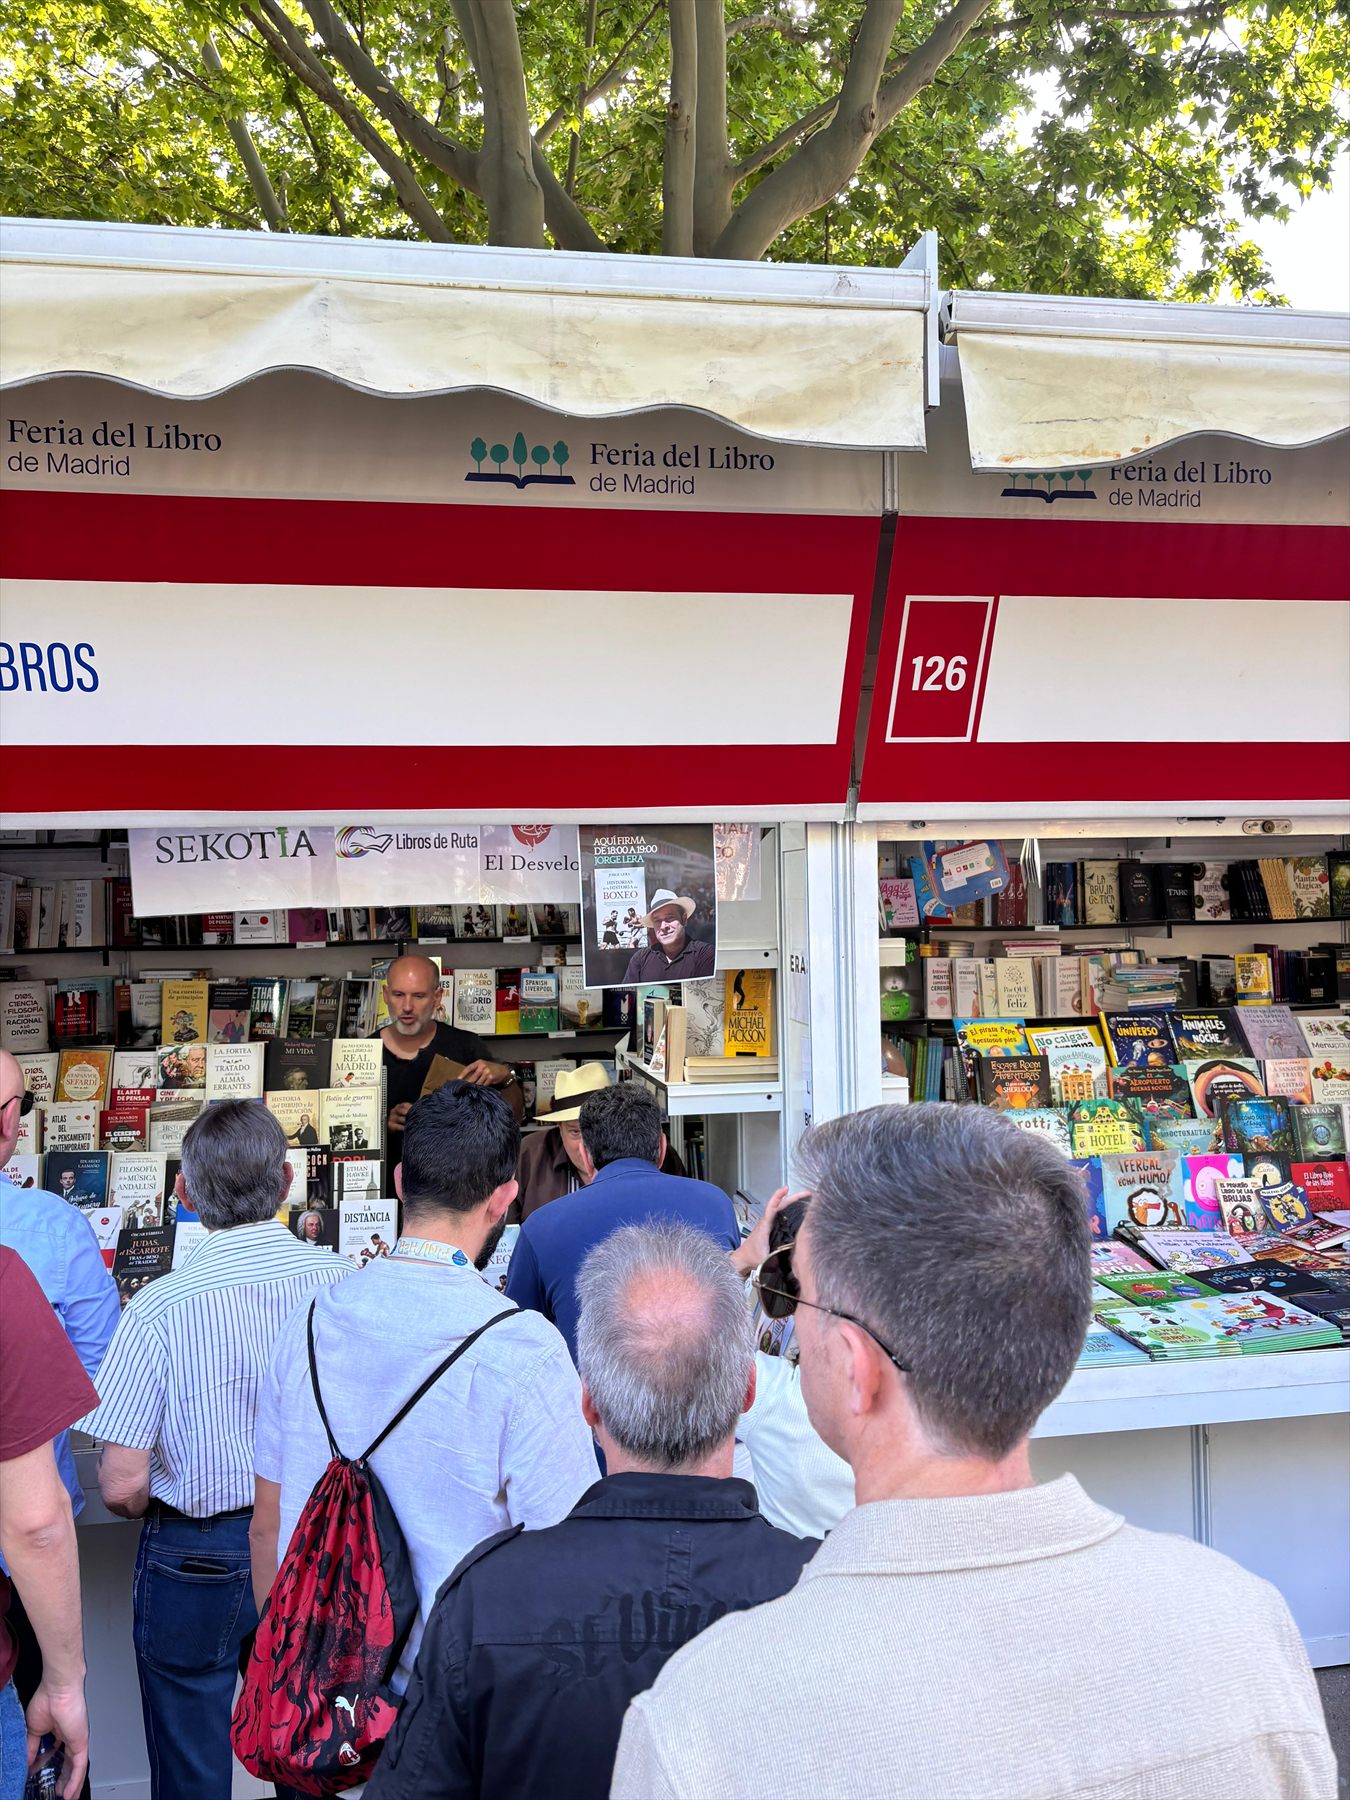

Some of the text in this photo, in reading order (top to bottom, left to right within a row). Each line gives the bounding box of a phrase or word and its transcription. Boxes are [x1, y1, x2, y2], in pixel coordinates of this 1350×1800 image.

[7, 419, 221, 453] Feria del Libro
[590, 443, 775, 471] Feria del Libro
[8, 451, 130, 476] de Madrid
[1109, 462, 1272, 485] Feria del Libro
[590, 473, 695, 495] de Madrid
[1109, 488, 1201, 508] de Madrid
[912, 656, 968, 691] 126
[396, 833, 478, 850] Libros de Ruta
[593, 834, 646, 847] AQUÍ FIRMA
[594, 844, 658, 855] DE 18:00 A 19:00
[484, 855, 502, 870] El
[594, 855, 644, 866] JORGE LERA
[1097, 875, 1106, 885] LA
[603, 891, 638, 900] BOXEO
[1008, 999, 1028, 1008] feliz
[6, 1018, 42, 1026] RACIONAL
[458, 1014, 492, 1022] HISTORIA
[728, 1017, 765, 1030] MICHAEL
[978, 1027, 998, 1036] pirata
[1000, 1026, 1016, 1036] Pepe
[1182, 1020, 1226, 1031] ANIMALES
[728, 1030, 766, 1042] JACKSON
[1116, 1026, 1158, 1037] UNIVERSO
[1036, 1032, 1088, 1047] No caigas
[1192, 1034, 1221, 1043] NOCHE
[343, 1054, 370, 1062] REAL
[336, 1062, 376, 1070] MADRID
[991, 1060, 1041, 1070] ESCAPE ROOM
[992, 1070, 1040, 1083] AVENTURAS
[1300, 1106, 1335, 1114] AVALON
[58, 1124, 66, 1132] DEL
[1017, 1118, 1050, 1131] rotti
[58, 1134, 90, 1142] PENSAMIENTO
[1170, 1128, 1212, 1138] OCTONAUTAS
[1090, 1134, 1126, 1147] HOTEL
[50, 1142, 90, 1152] CONTEMPORÁNEO
[120, 1165, 158, 1173] FILOSOFÍA
[128, 1174, 156, 1182] MÚSICA
[1139, 1169, 1170, 1184] HUMO!
[118, 1182, 156, 1191] ANDALUSÍ
[1222, 1195, 1252, 1203] BRUJAS
[363, 1204, 371, 1212] LA
[344, 1212, 390, 1223] DISTANCIA
[132, 1238, 160, 1250] JUDAS,
[126, 1246, 170, 1256] ISCARIOTE
